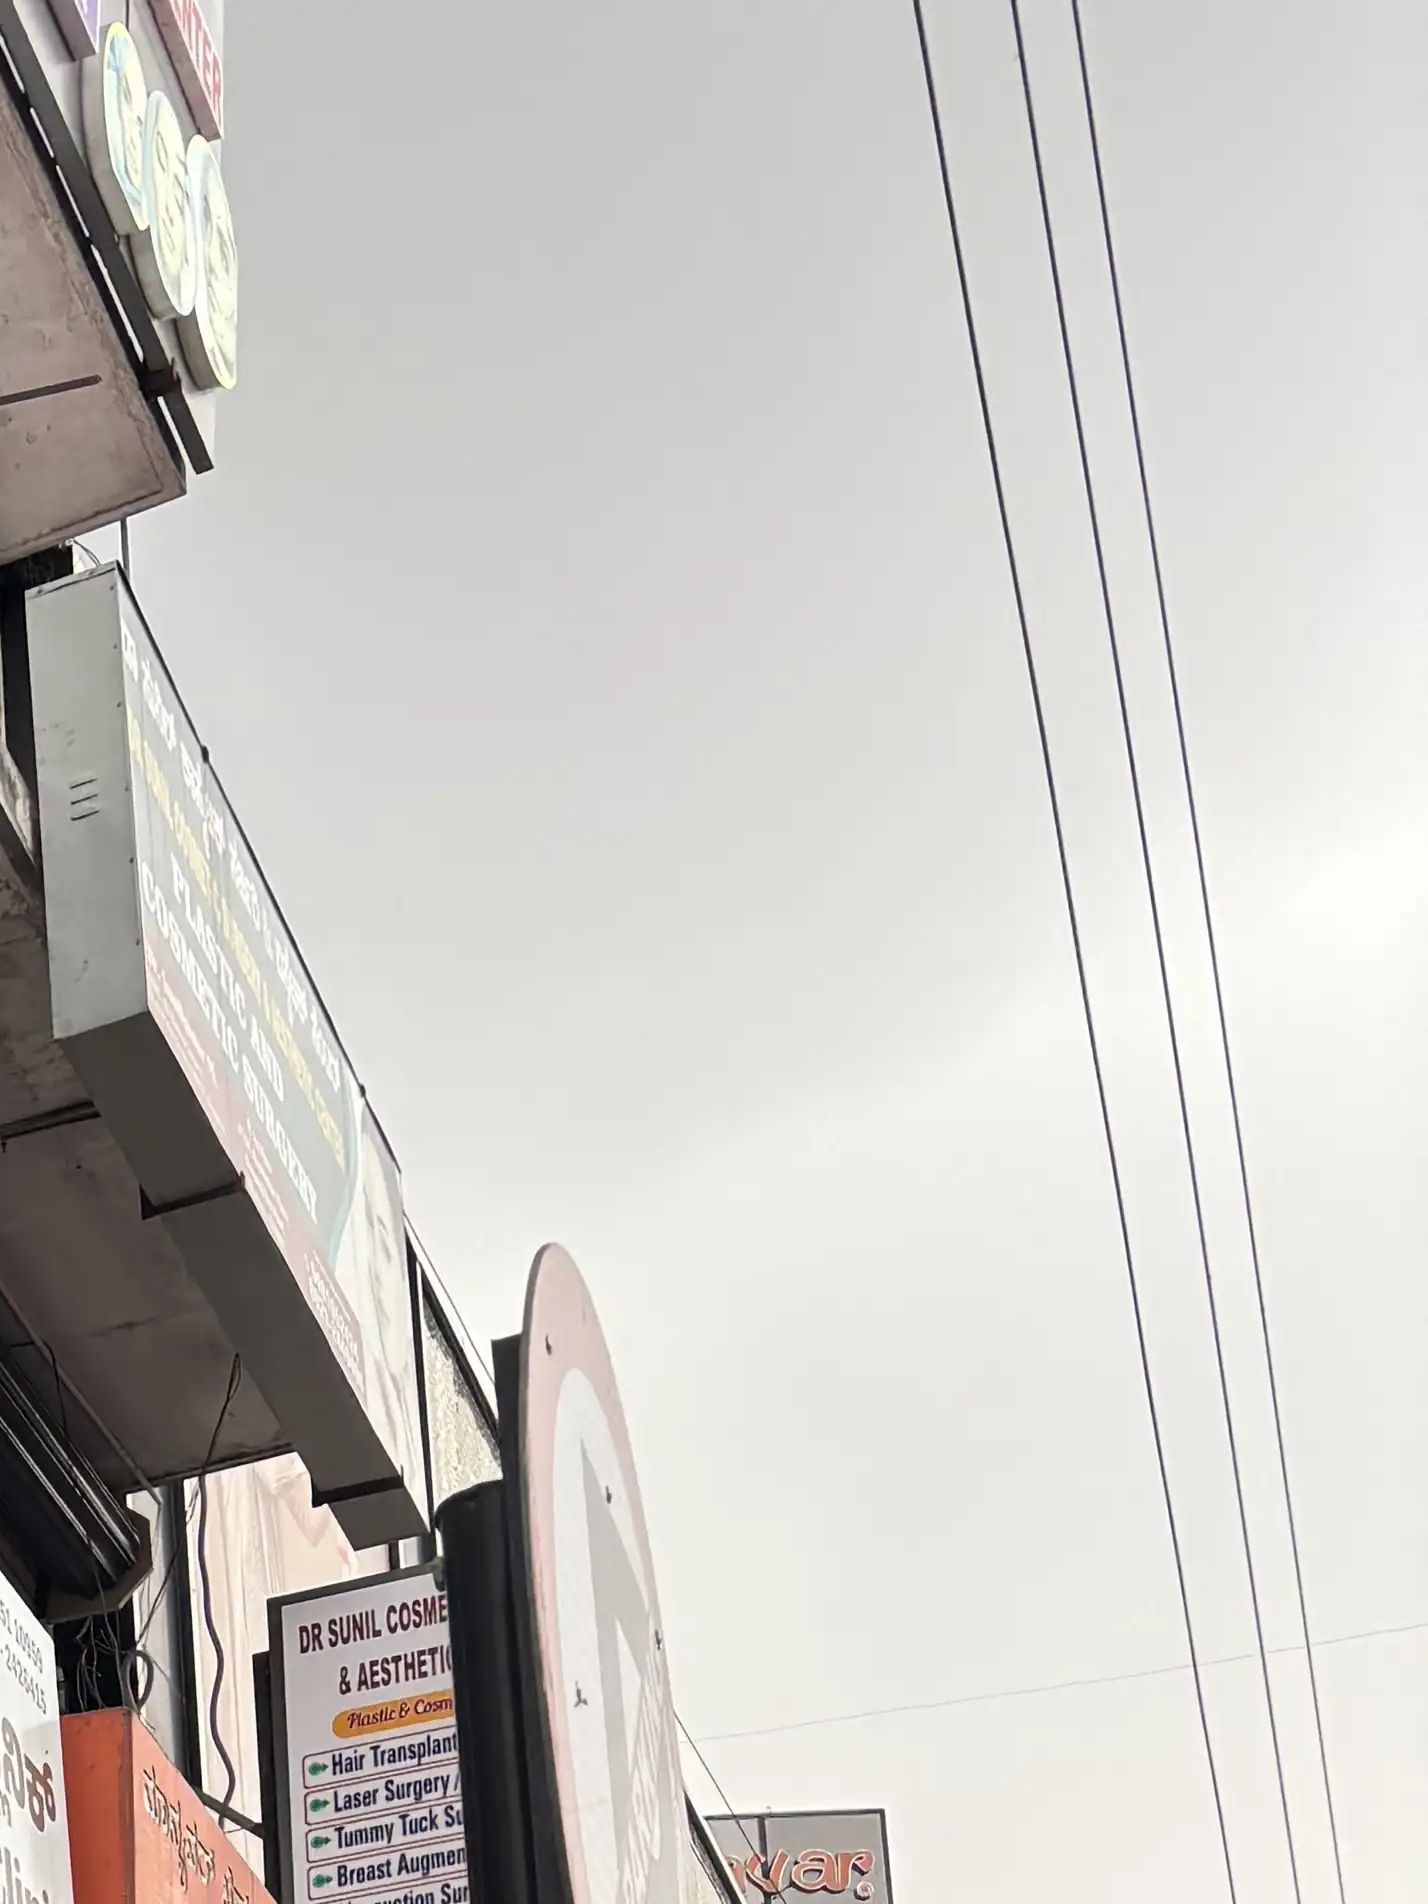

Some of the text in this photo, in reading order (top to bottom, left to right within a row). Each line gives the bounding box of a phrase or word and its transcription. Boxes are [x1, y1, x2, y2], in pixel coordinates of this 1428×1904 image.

[170, 852, 246, 1034] PLASTIC
[248, 1018, 284, 1102] AND
[140, 858, 241, 1078] COSMETIC
[242, 1052, 318, 1226] SURGERY
[298, 1622, 324, 1655] DR
[327, 1608, 382, 1649] SUNIL
[339, 1666, 352, 1695] &
[346, 1705, 395, 1730] Plastic
[397, 1701, 411, 1719] &
[331, 1730, 459, 1777] Hair Transplant
[332, 1774, 449, 1812] Laser Surgery
[334, 1811, 440, 1852] Tummy Tuck
[337, 1860, 392, 1888] Breast
